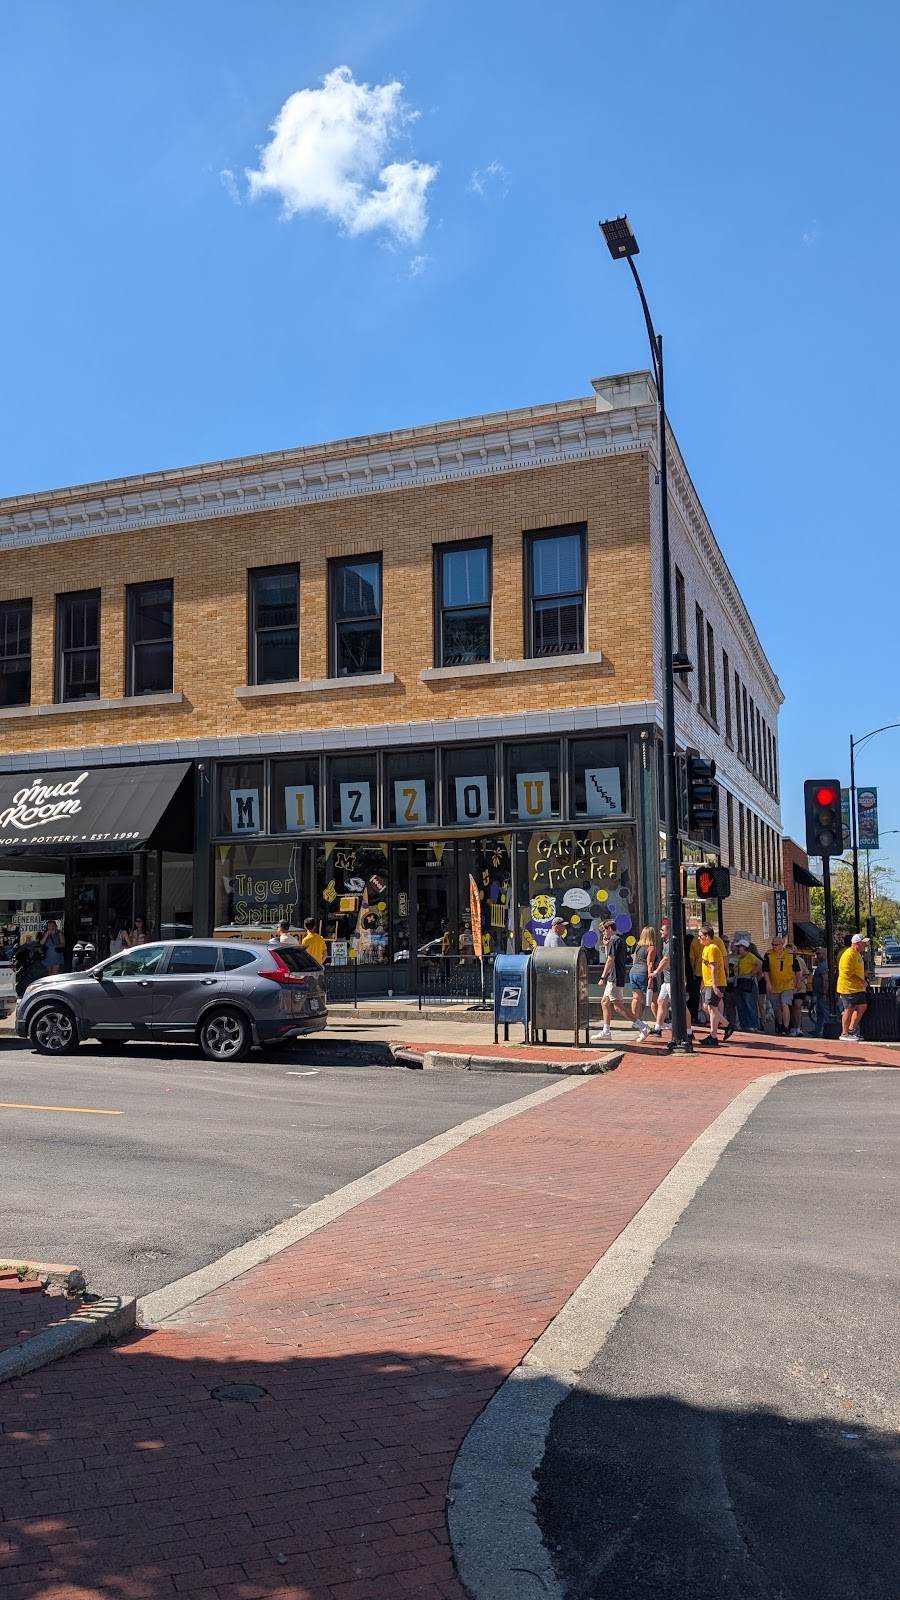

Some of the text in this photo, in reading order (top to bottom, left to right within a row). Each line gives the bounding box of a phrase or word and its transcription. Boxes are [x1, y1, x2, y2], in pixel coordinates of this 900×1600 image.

[589, 774, 616, 809] TIGERS
[0, 798, 82, 830] Room
[30, 834, 78, 844] POTTERY
[90, 832, 110, 841] EST
[112, 831, 140, 840] 1998
[235, 874, 294, 903] Tiger
[12, 915, 43, 924] GENERAL
[234, 900, 294, 928] Spirit
[775, 892, 783, 938] HEXAGON
